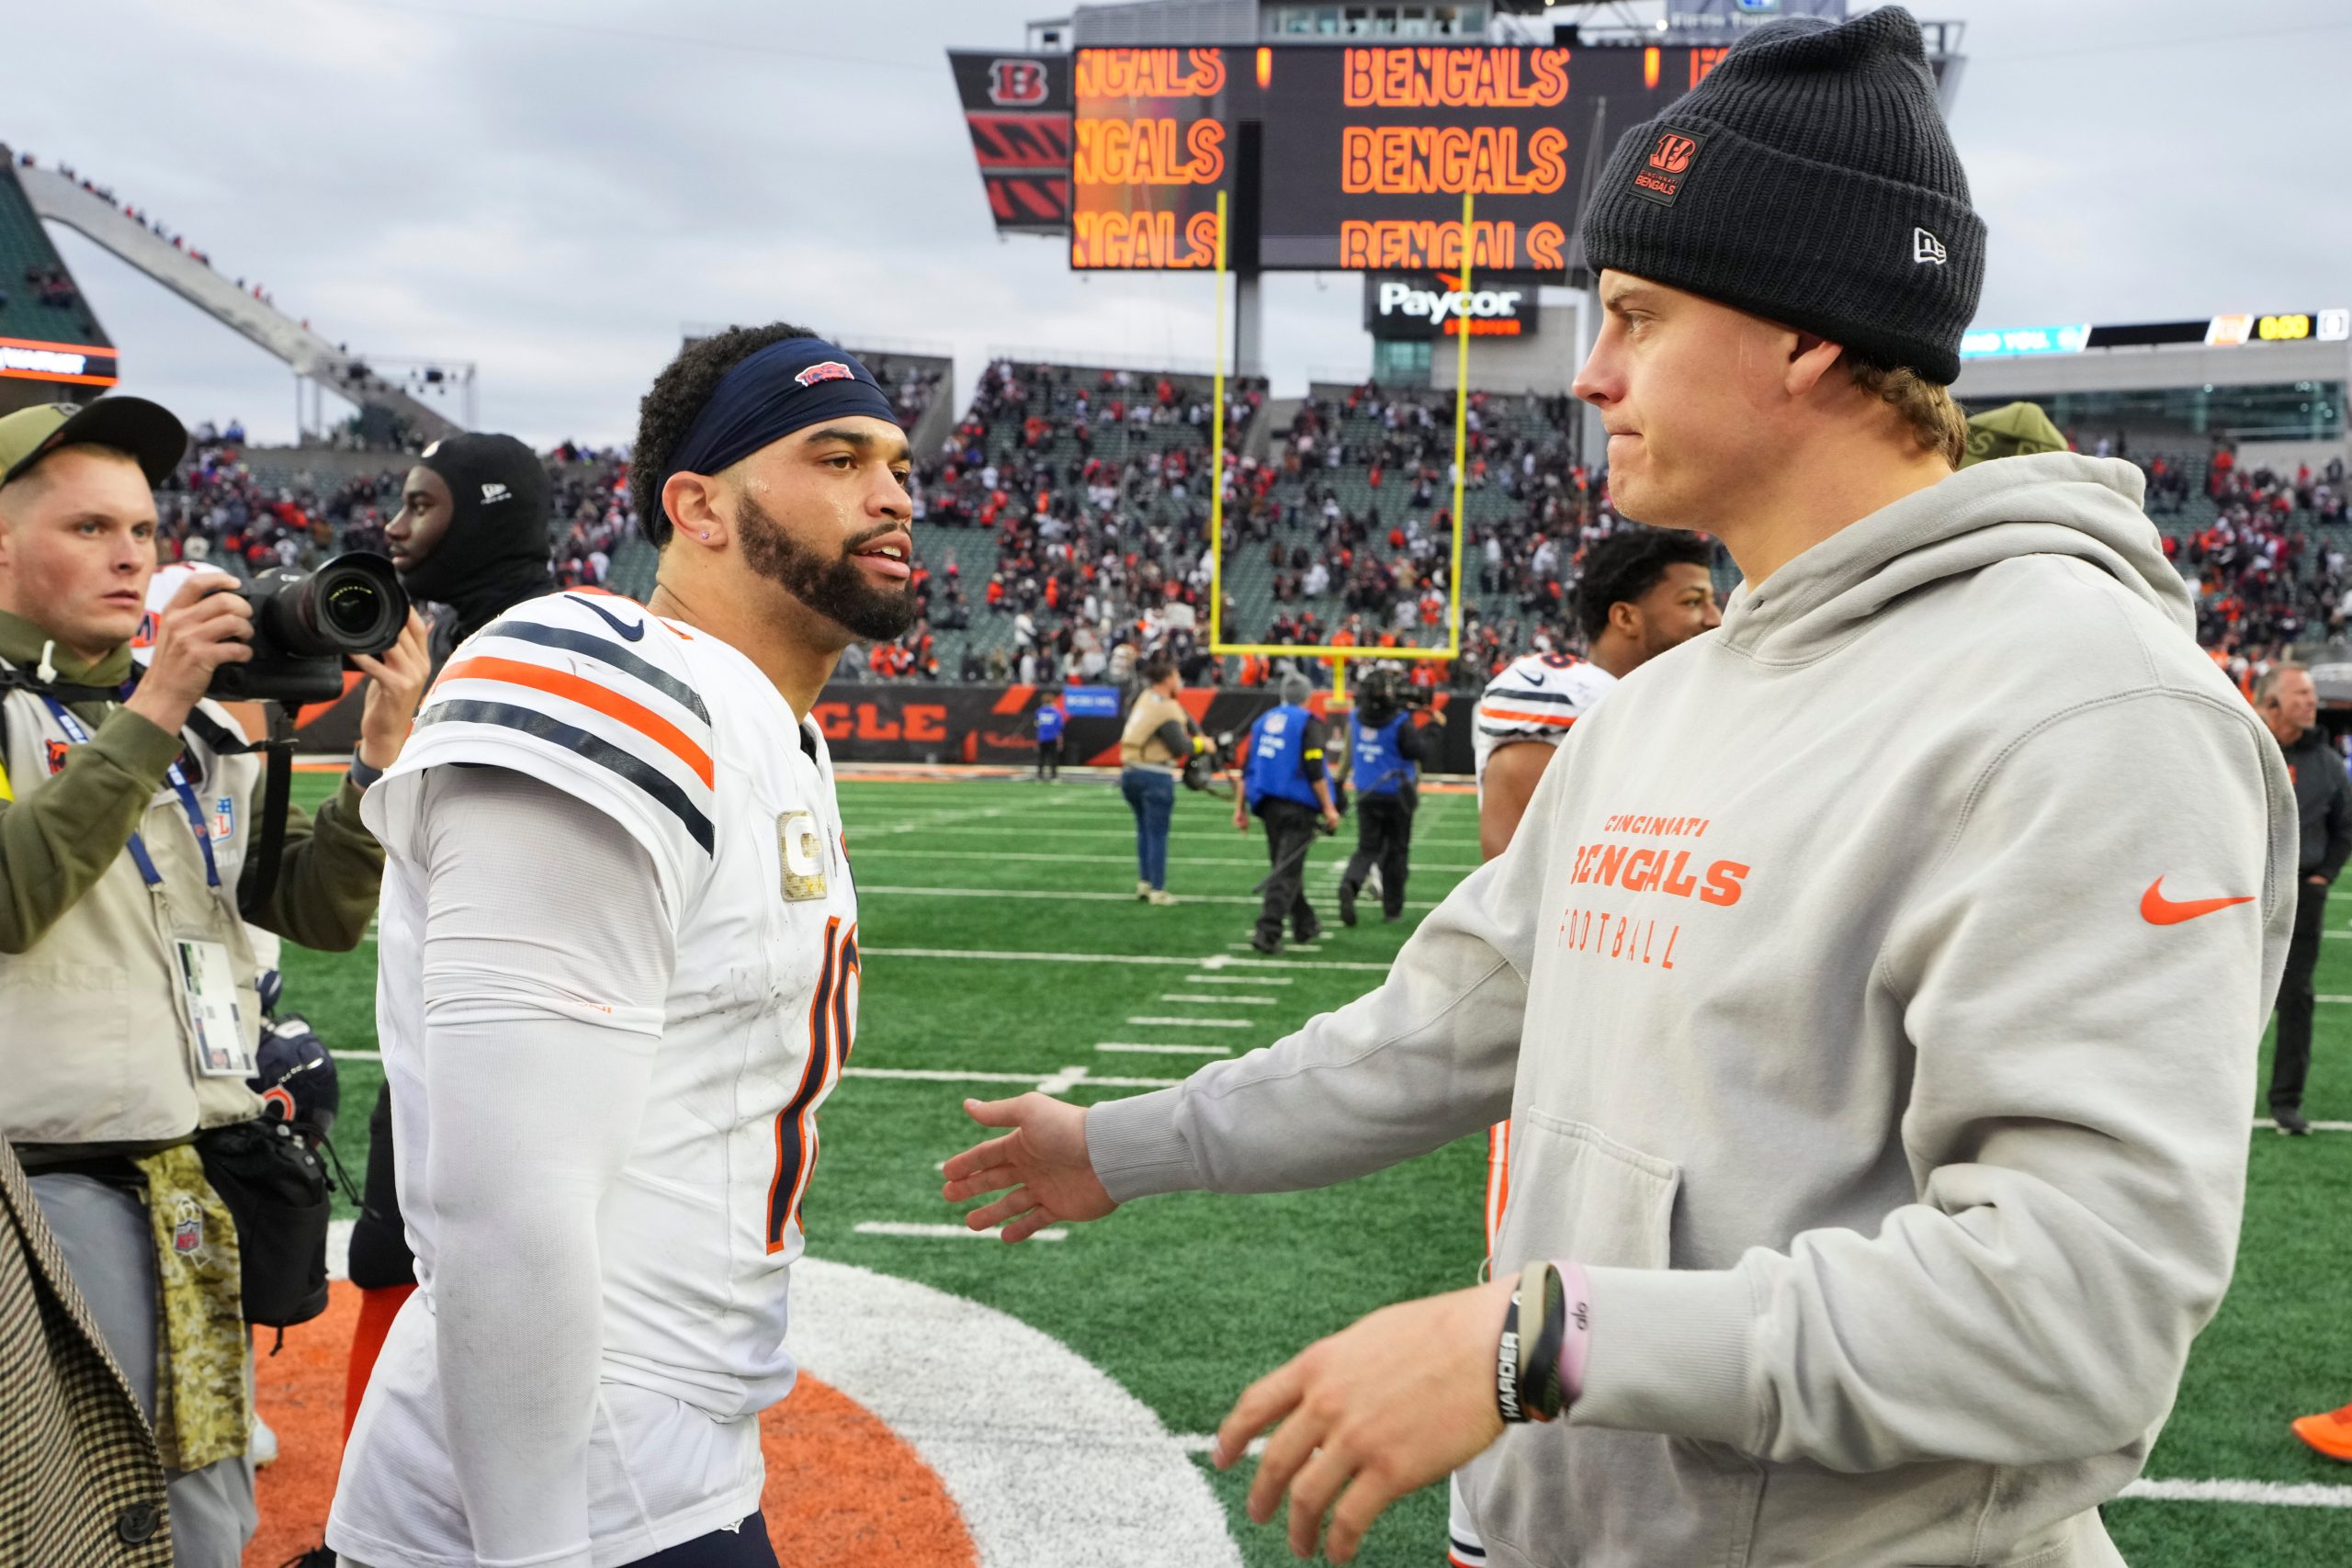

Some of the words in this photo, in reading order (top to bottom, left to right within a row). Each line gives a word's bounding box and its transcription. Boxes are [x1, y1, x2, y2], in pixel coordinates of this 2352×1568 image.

[1343, 48, 1570, 107] BENGALS
[1341, 126, 1568, 194] BENGALS
[1634, 175, 1676, 196] BENGALS
[1379, 282, 1522, 324] Paycor
